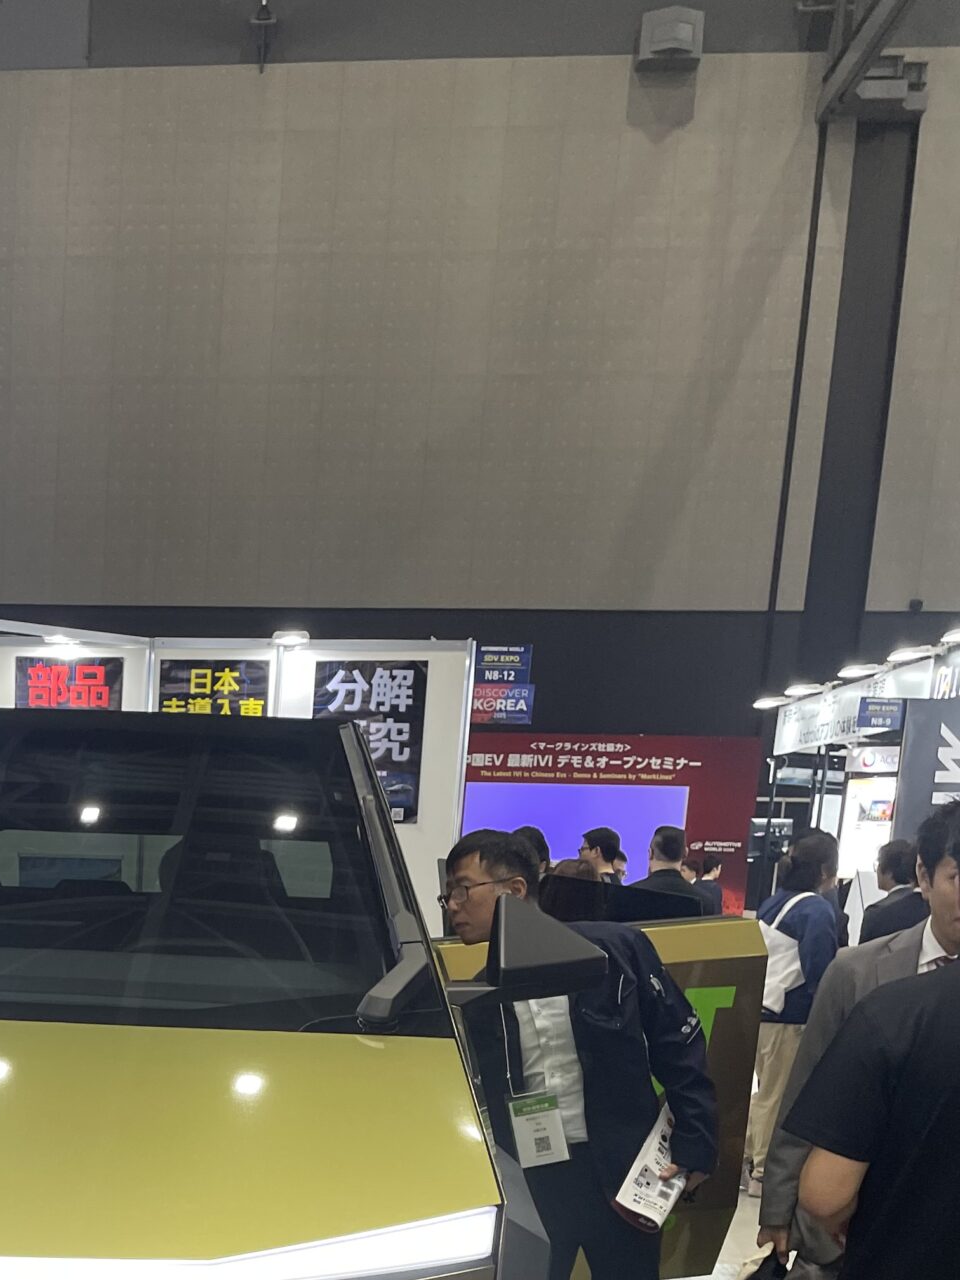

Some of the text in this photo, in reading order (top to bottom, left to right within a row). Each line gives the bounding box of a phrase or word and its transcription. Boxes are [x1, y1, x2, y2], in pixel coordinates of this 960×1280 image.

[28, 662, 109, 708] 部品
[190, 667, 239, 695] 日本
[326, 667, 414, 712] 分解
[484, 670, 515, 681] N8-12
[473, 698, 527, 711] KOREA
[474, 688, 528, 698] DISCOVER
[354, 718, 410, 762] 究
